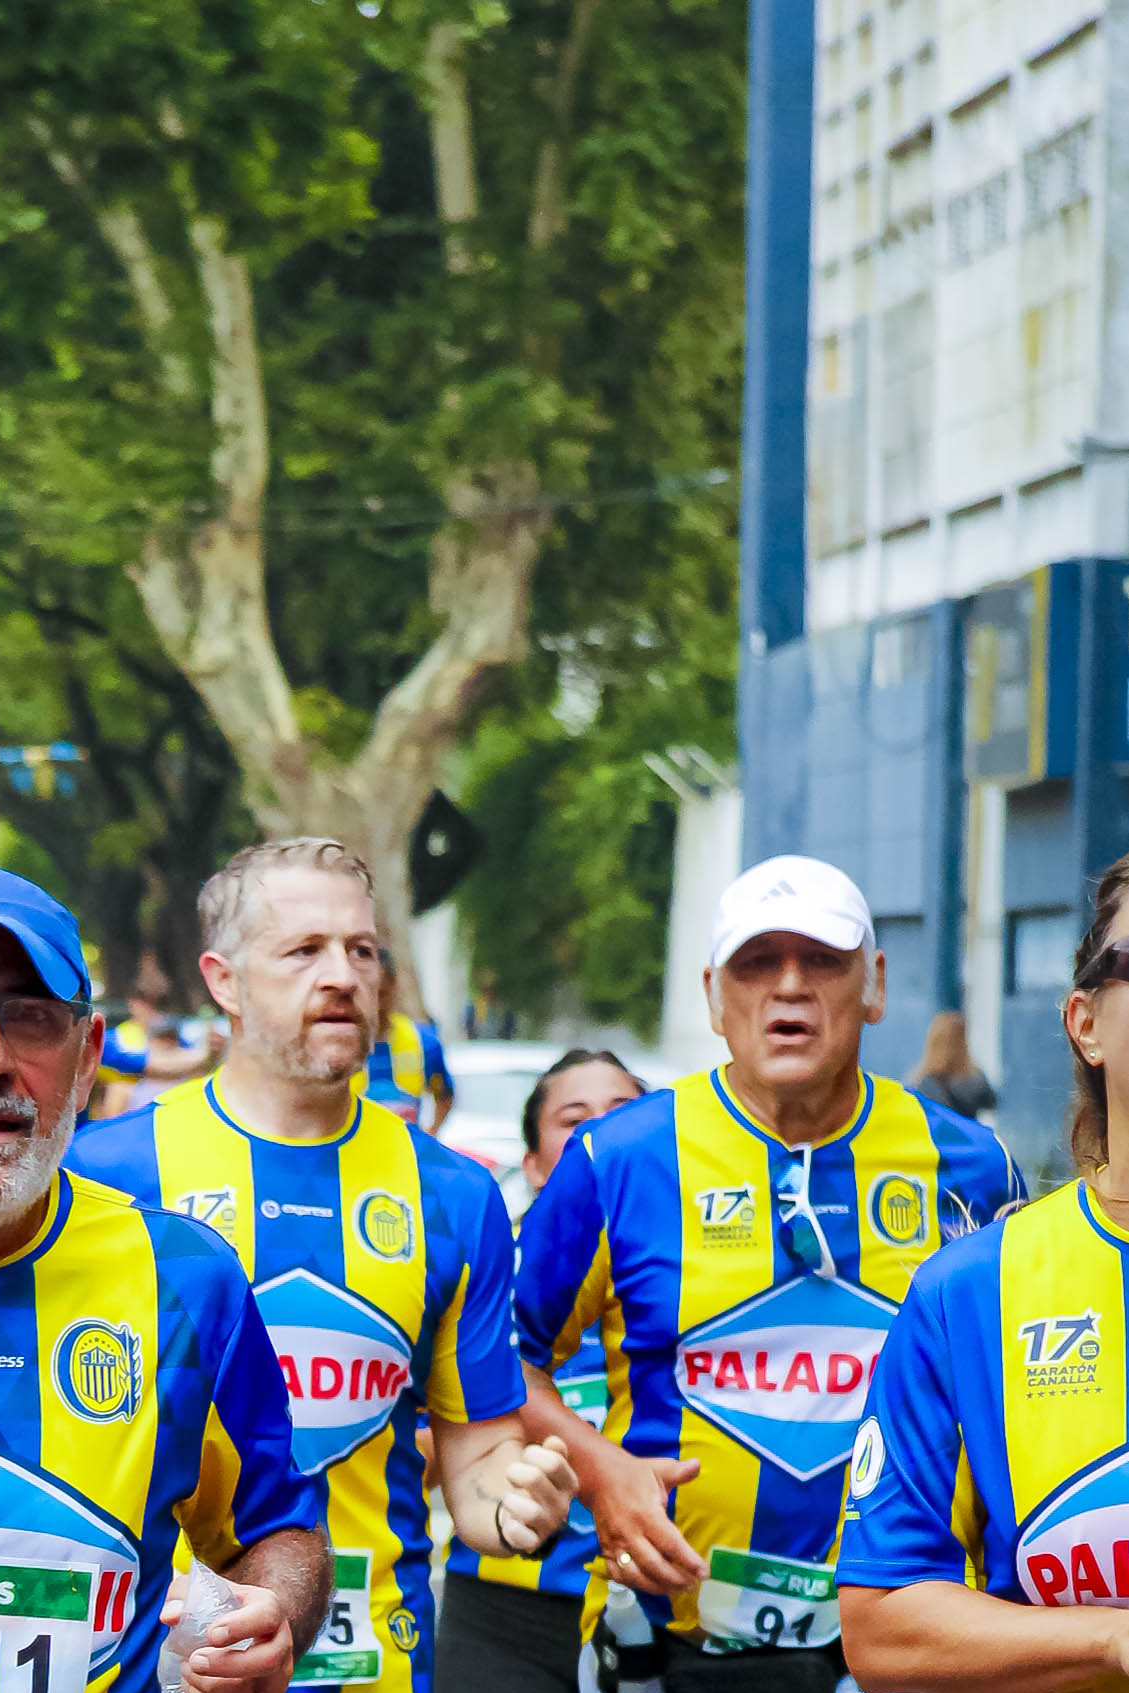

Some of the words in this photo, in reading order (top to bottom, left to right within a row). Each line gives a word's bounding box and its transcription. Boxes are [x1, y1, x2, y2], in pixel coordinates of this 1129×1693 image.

[699, 1188, 751, 1222] 17
[1020, 1314, 1098, 1362] 17
[277, 1354, 409, 1400] ADIN
[684, 1351, 879, 1393] PALAD
[1026, 1363, 1097, 1377] MARATÓN
[1027, 1374, 1096, 1387] CANALLA
